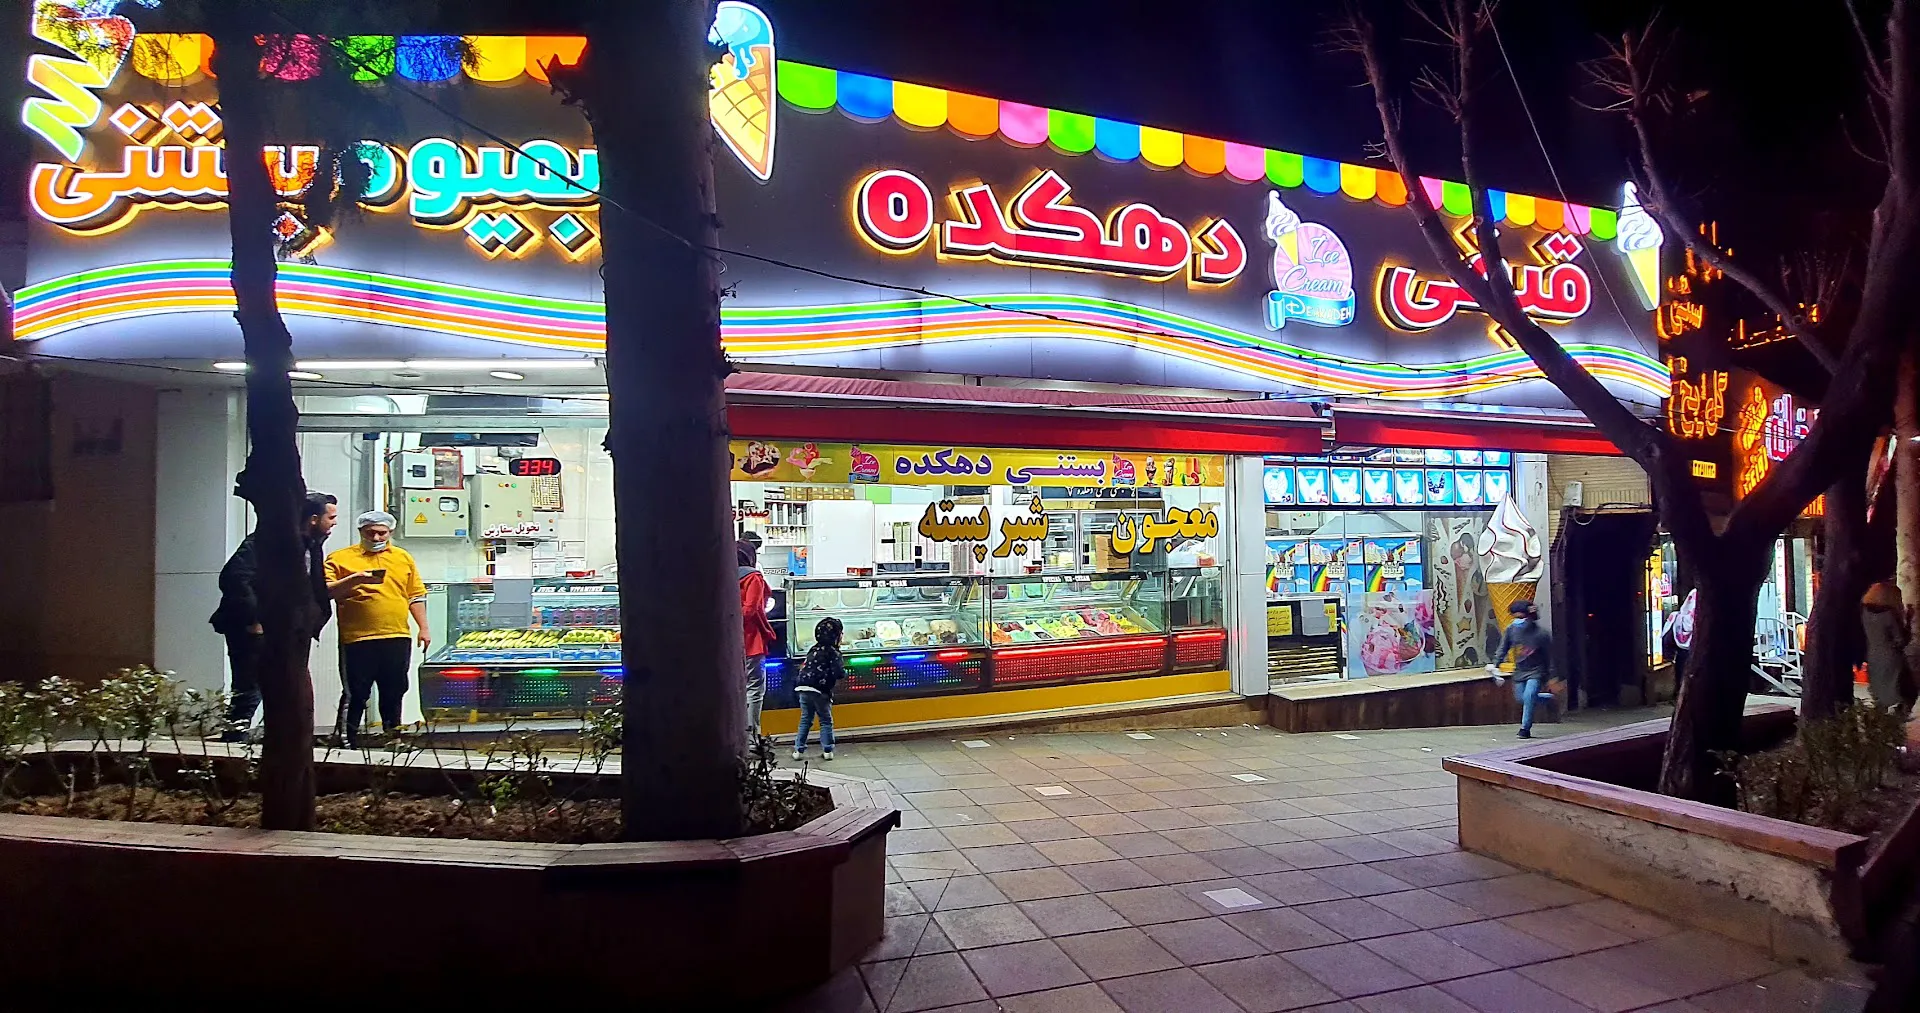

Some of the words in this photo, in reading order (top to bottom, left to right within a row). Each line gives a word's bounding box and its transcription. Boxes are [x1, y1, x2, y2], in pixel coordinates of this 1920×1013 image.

[856, 169, 1248, 283] دهکده
[1304, 234, 1340, 267] Ice
[1282, 264, 1344, 296] Cream
[1388, 232, 1591, 330] قیی
[518, 459, 554, 475] 334
[895, 449, 992, 475] دهکده
[1006, 455, 1105, 485] بستنی
[484, 523, 513, 537] سفارش
[515, 522, 540, 535] تحویل
[918, 499, 991, 563] پسته
[992, 495, 1050, 557] شیر
[1110, 506, 1220, 554] معجون
